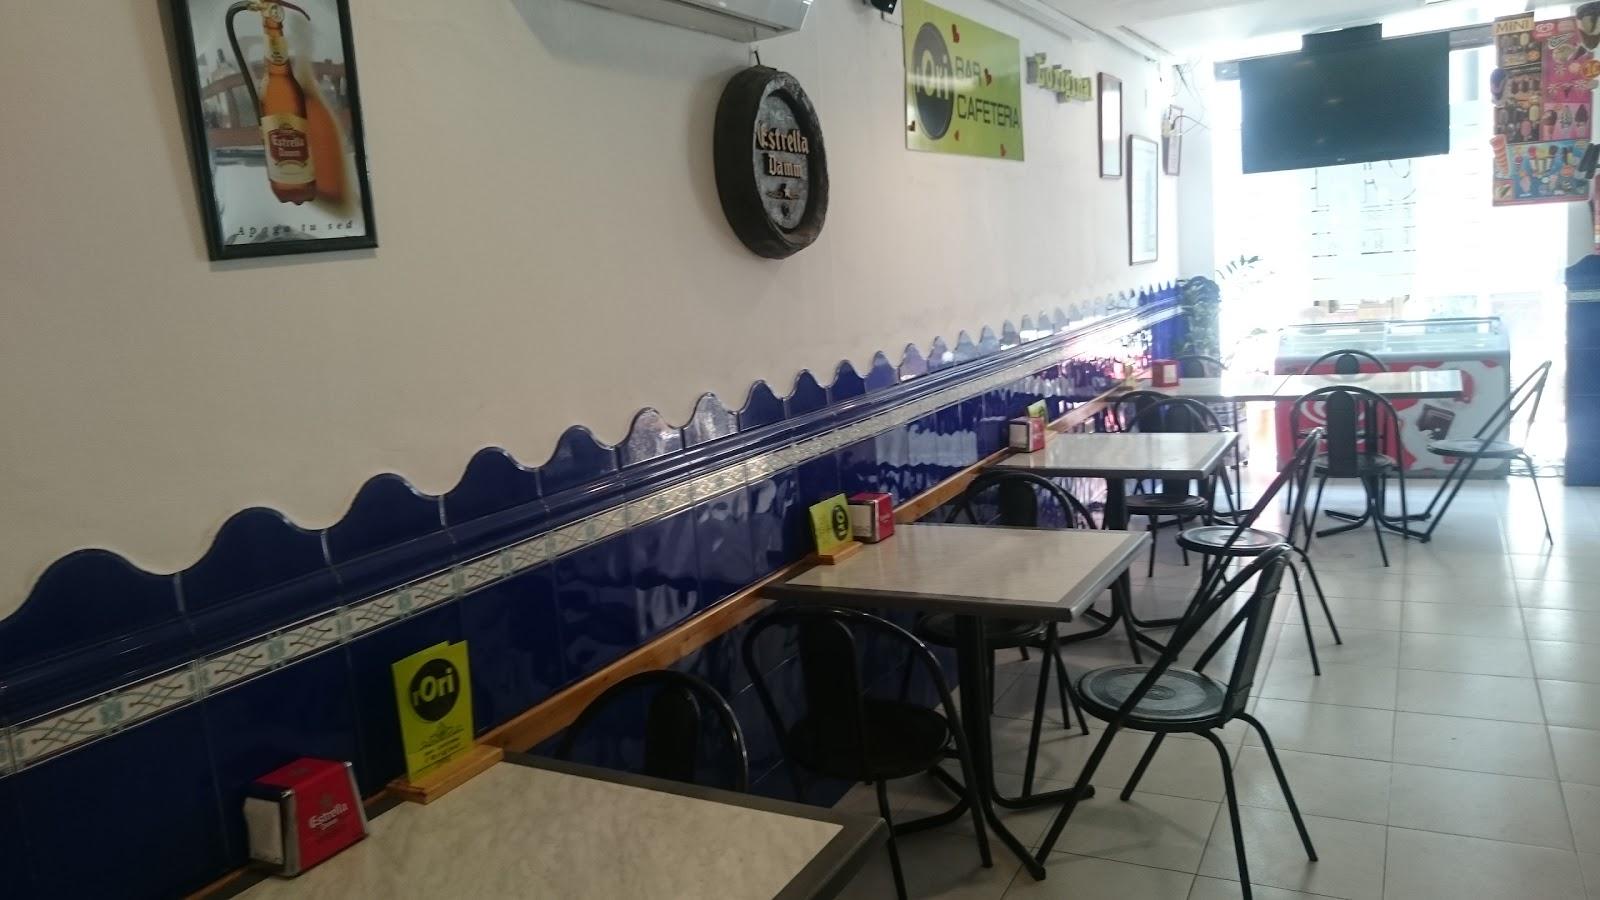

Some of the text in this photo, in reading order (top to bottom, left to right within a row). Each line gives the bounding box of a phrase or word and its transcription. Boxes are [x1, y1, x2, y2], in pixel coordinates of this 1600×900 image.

[1496, 20, 1530, 34] MINI
[955, 56, 982, 86] BAR
[956, 94, 1019, 128] CAFETERIA
[757, 127, 809, 154] Estrella
[768, 153, 801, 178] Damm
[309, 803, 349, 829] Estrella
